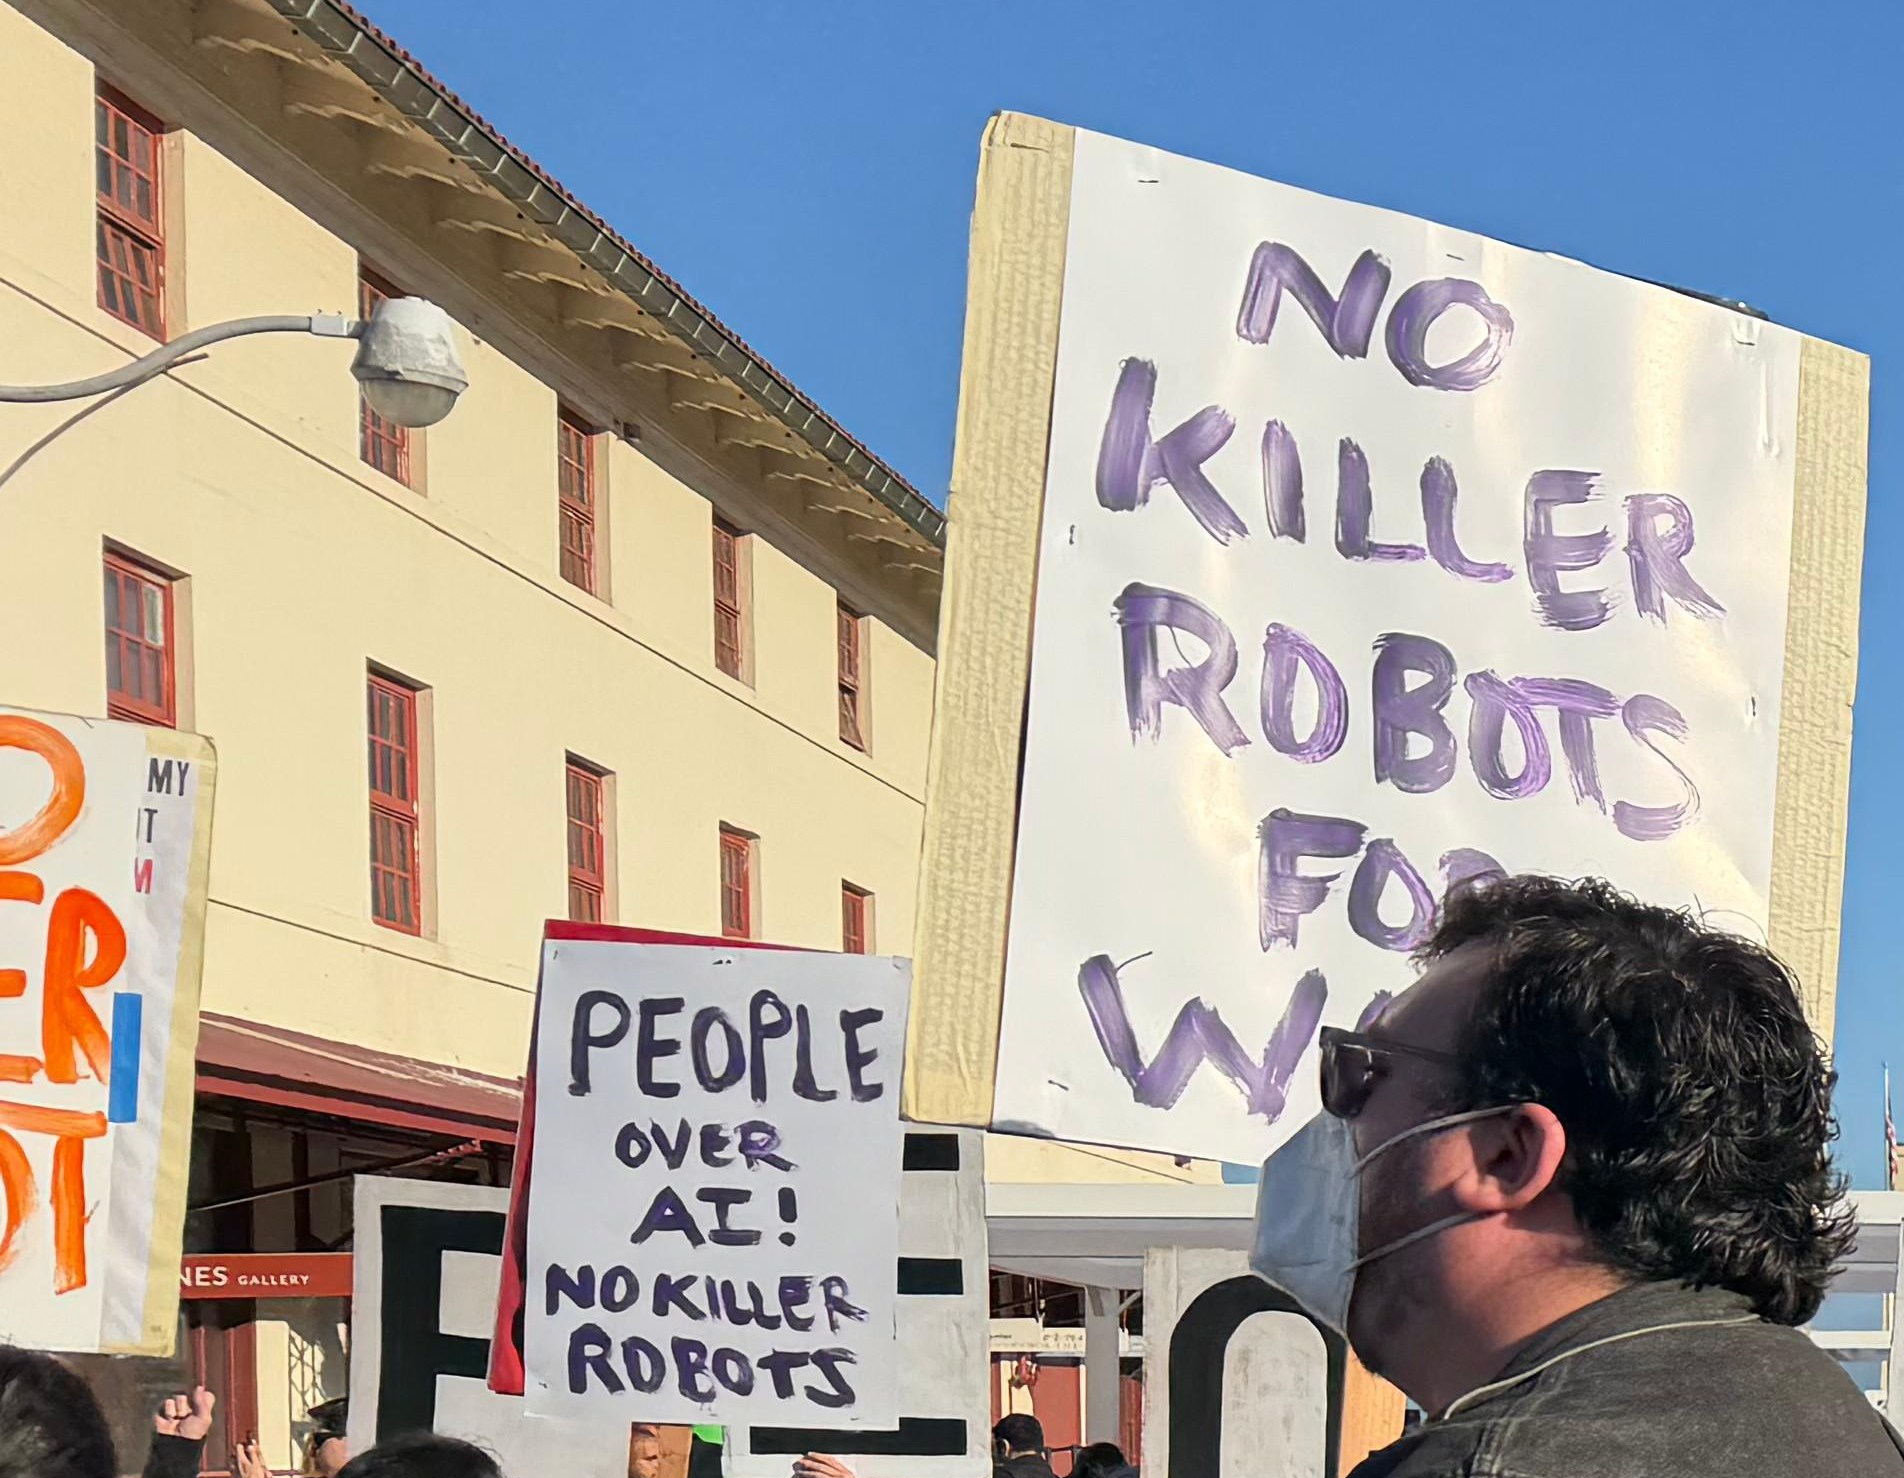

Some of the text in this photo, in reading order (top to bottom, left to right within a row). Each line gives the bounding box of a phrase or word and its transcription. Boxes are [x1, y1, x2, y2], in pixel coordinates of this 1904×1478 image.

[1236, 240, 1515, 391] NO
[1095, 356, 1727, 631] KILLER
[1111, 581, 1701, 841] ROBOTS
[568, 989, 887, 1103] PEOPLE
[615, 1119, 799, 1171] OVER
[630, 1187, 799, 1248] AI!
[237, 1275, 310, 1286] GALLERY
[546, 1264, 870, 1332] NO KILLER
[568, 1323, 859, 1409] ROBOTS
